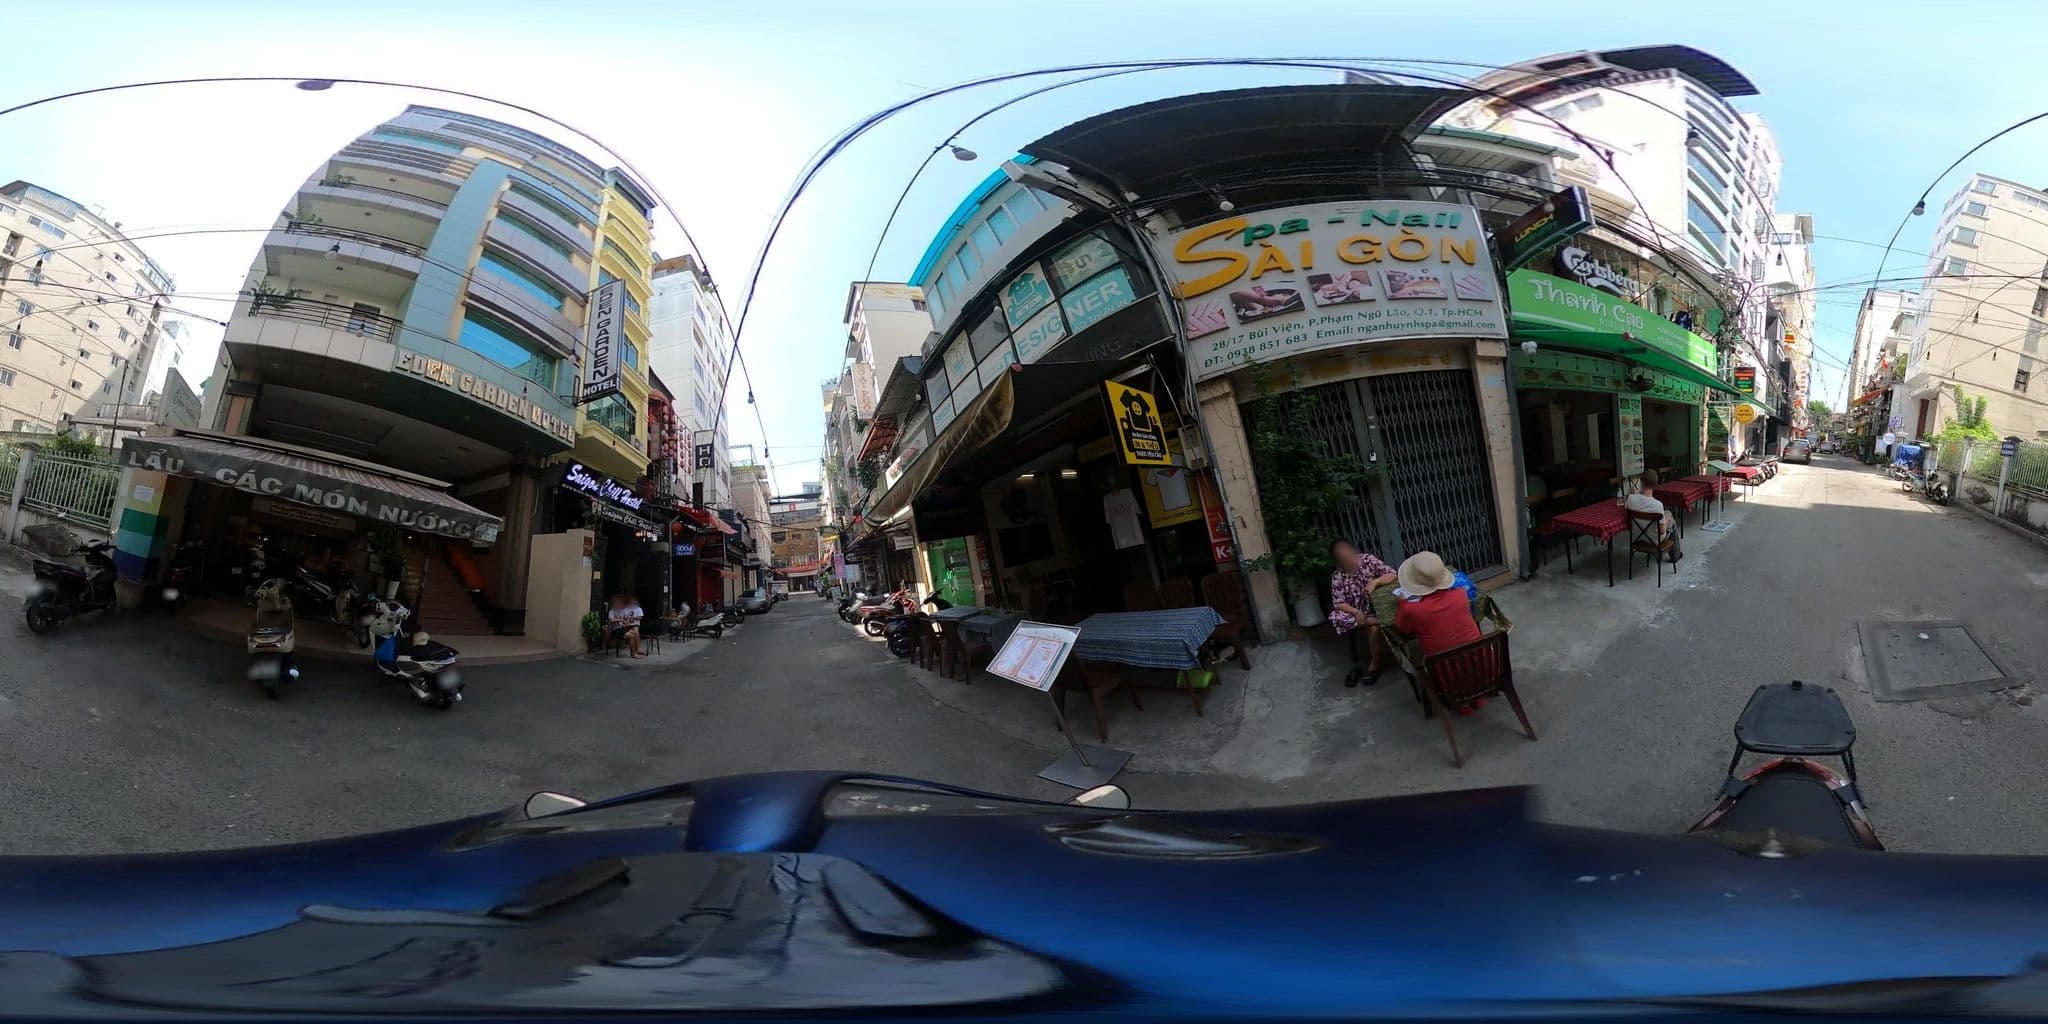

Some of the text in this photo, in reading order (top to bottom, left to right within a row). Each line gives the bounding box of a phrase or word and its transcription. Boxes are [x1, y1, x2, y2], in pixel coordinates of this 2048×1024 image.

[1361, 208, 1462, 229] Nail
[1337, 226, 1476, 266] GÒN
[1528, 279, 1607, 317] Thanh
[1613, 305, 1644, 329] Cao
[593, 285, 614, 380] EDEN GARDEN
[1204, 319, 1496, 368] ĐT: 0938 851 683 Email: nganhuynhspa@gmail.com
[1212, 335, 1244, 351] 28/17
[1249, 328, 1268, 340] Bùi
[1272, 323, 1304, 334] Viện,
[1308, 314, 1353, 327] P.Phạm
[1357, 311, 1382, 322] Ngũ
[1441, 308, 1483, 317] Tp.HCM
[396, 349, 575, 443] EDEN GARDEN HOTEL
[583, 377, 616, 396] HOTEL
[215, 468, 282, 494] CÁC
[294, 484, 368, 515] MÓN
[379, 504, 472, 538] NƯỚNG
[567, 464, 600, 492] Saigon
[600, 479, 623, 501] Chill
